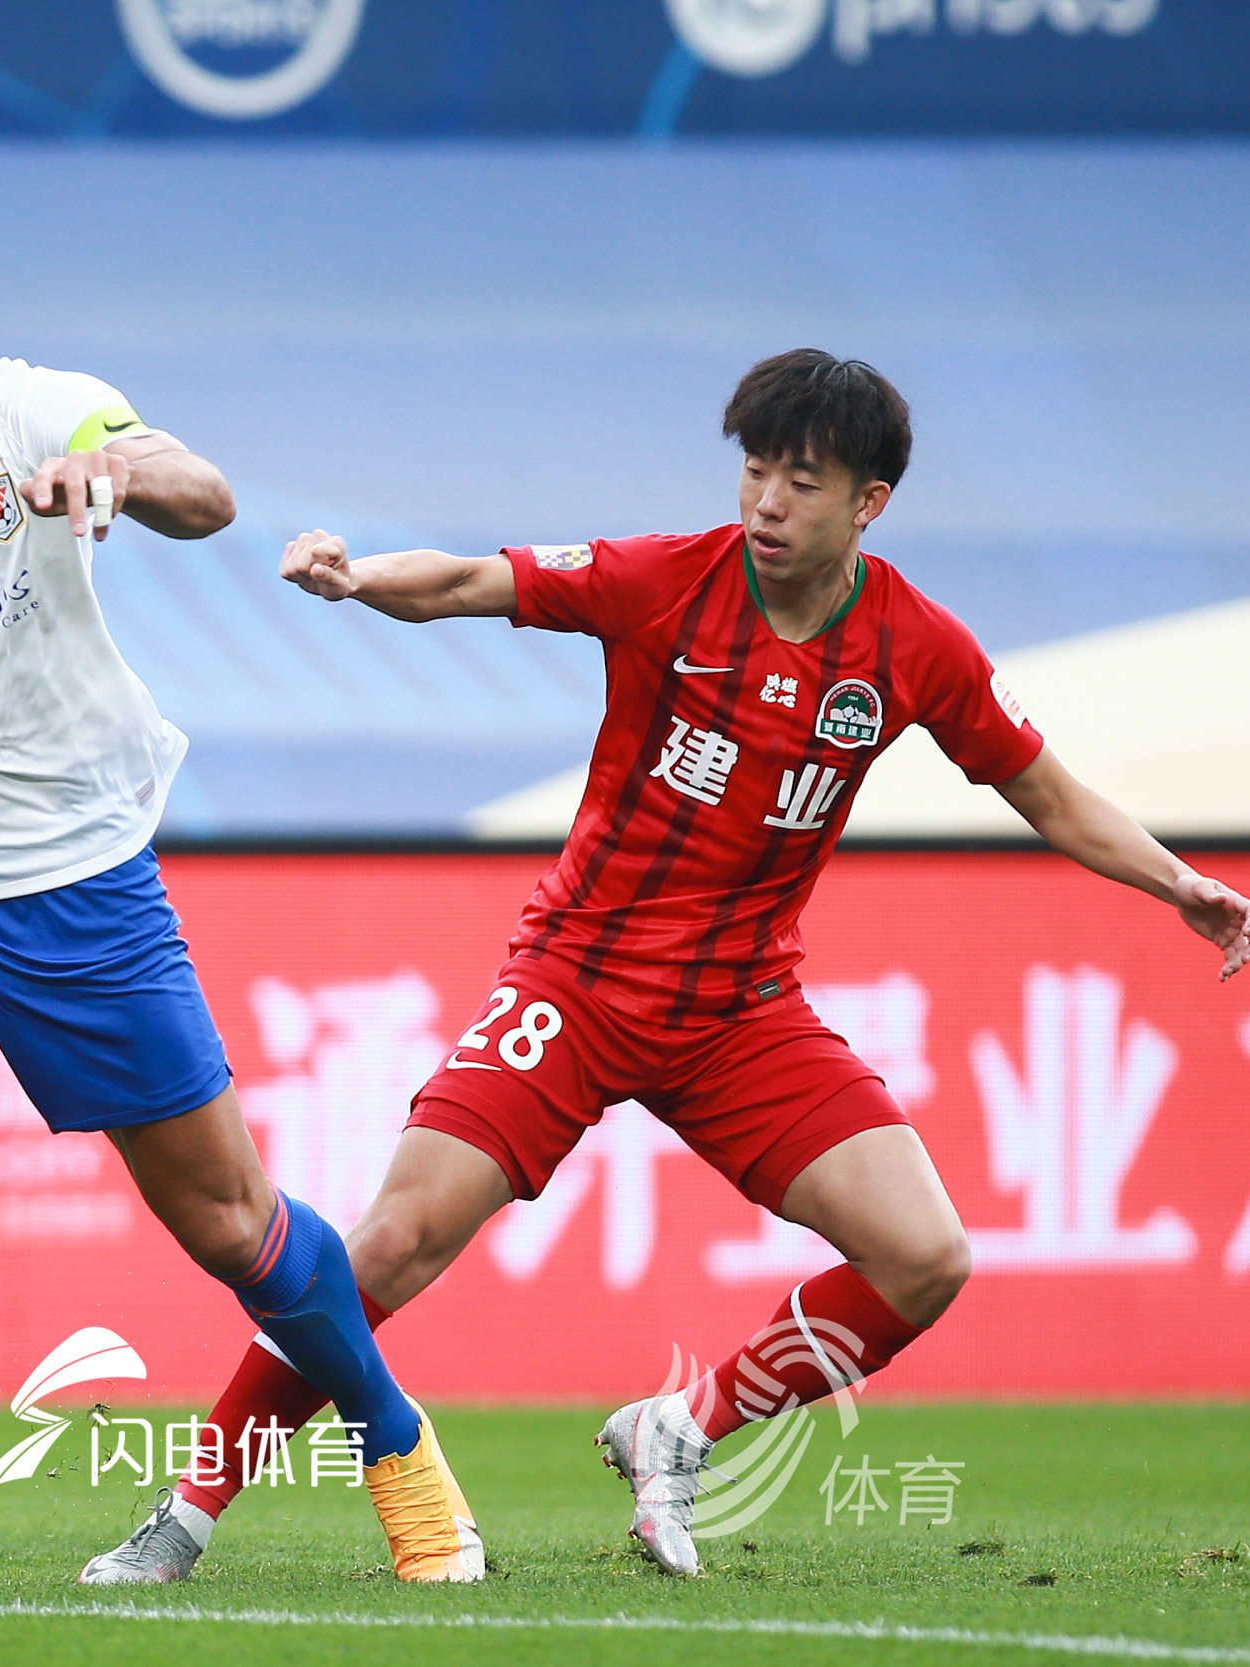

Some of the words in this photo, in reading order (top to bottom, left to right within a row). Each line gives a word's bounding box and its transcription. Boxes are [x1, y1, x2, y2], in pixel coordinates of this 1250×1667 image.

[1, 599, 40, 629] Care
[649, 714, 846, 830] 建业
[456, 986, 563, 1071] 28
